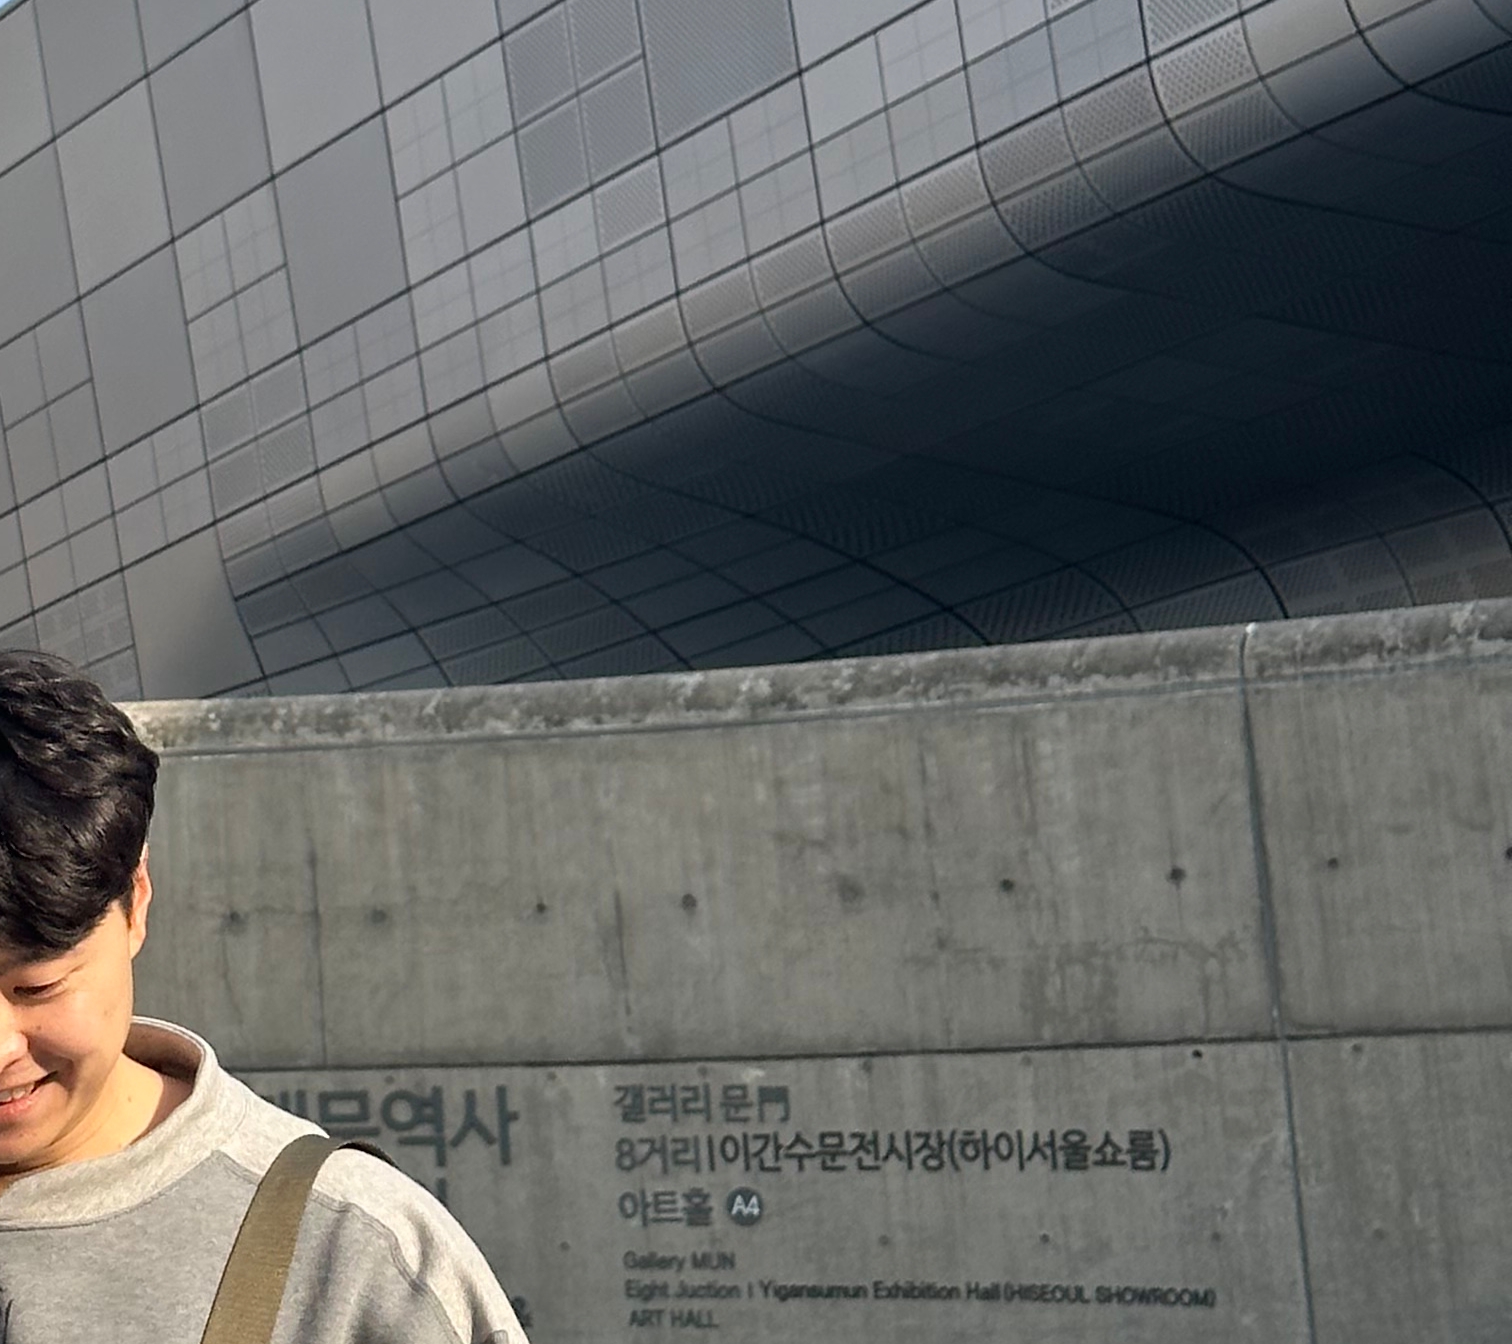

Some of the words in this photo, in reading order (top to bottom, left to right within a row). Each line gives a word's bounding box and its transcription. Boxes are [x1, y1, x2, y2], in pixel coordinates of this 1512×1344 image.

[613, 1082, 713, 1124] 갤러리
[262, 1084, 521, 1167] 문역사
[618, 1186, 713, 1228] 아트홀
[729, 1193, 761, 1217] A4
[623, 1250, 686, 1273] Gallery
[691, 1251, 736, 1270] MUN
[624, 1278, 670, 1302] Eight
[758, 1279, 869, 1302] Yigansumun
[872, 1280, 961, 1300] Exhibition
[1094, 1285, 1218, 1309] SHOWROOM)
[628, 1308, 666, 1327] ART
[670, 1309, 720, 1329] HALL
